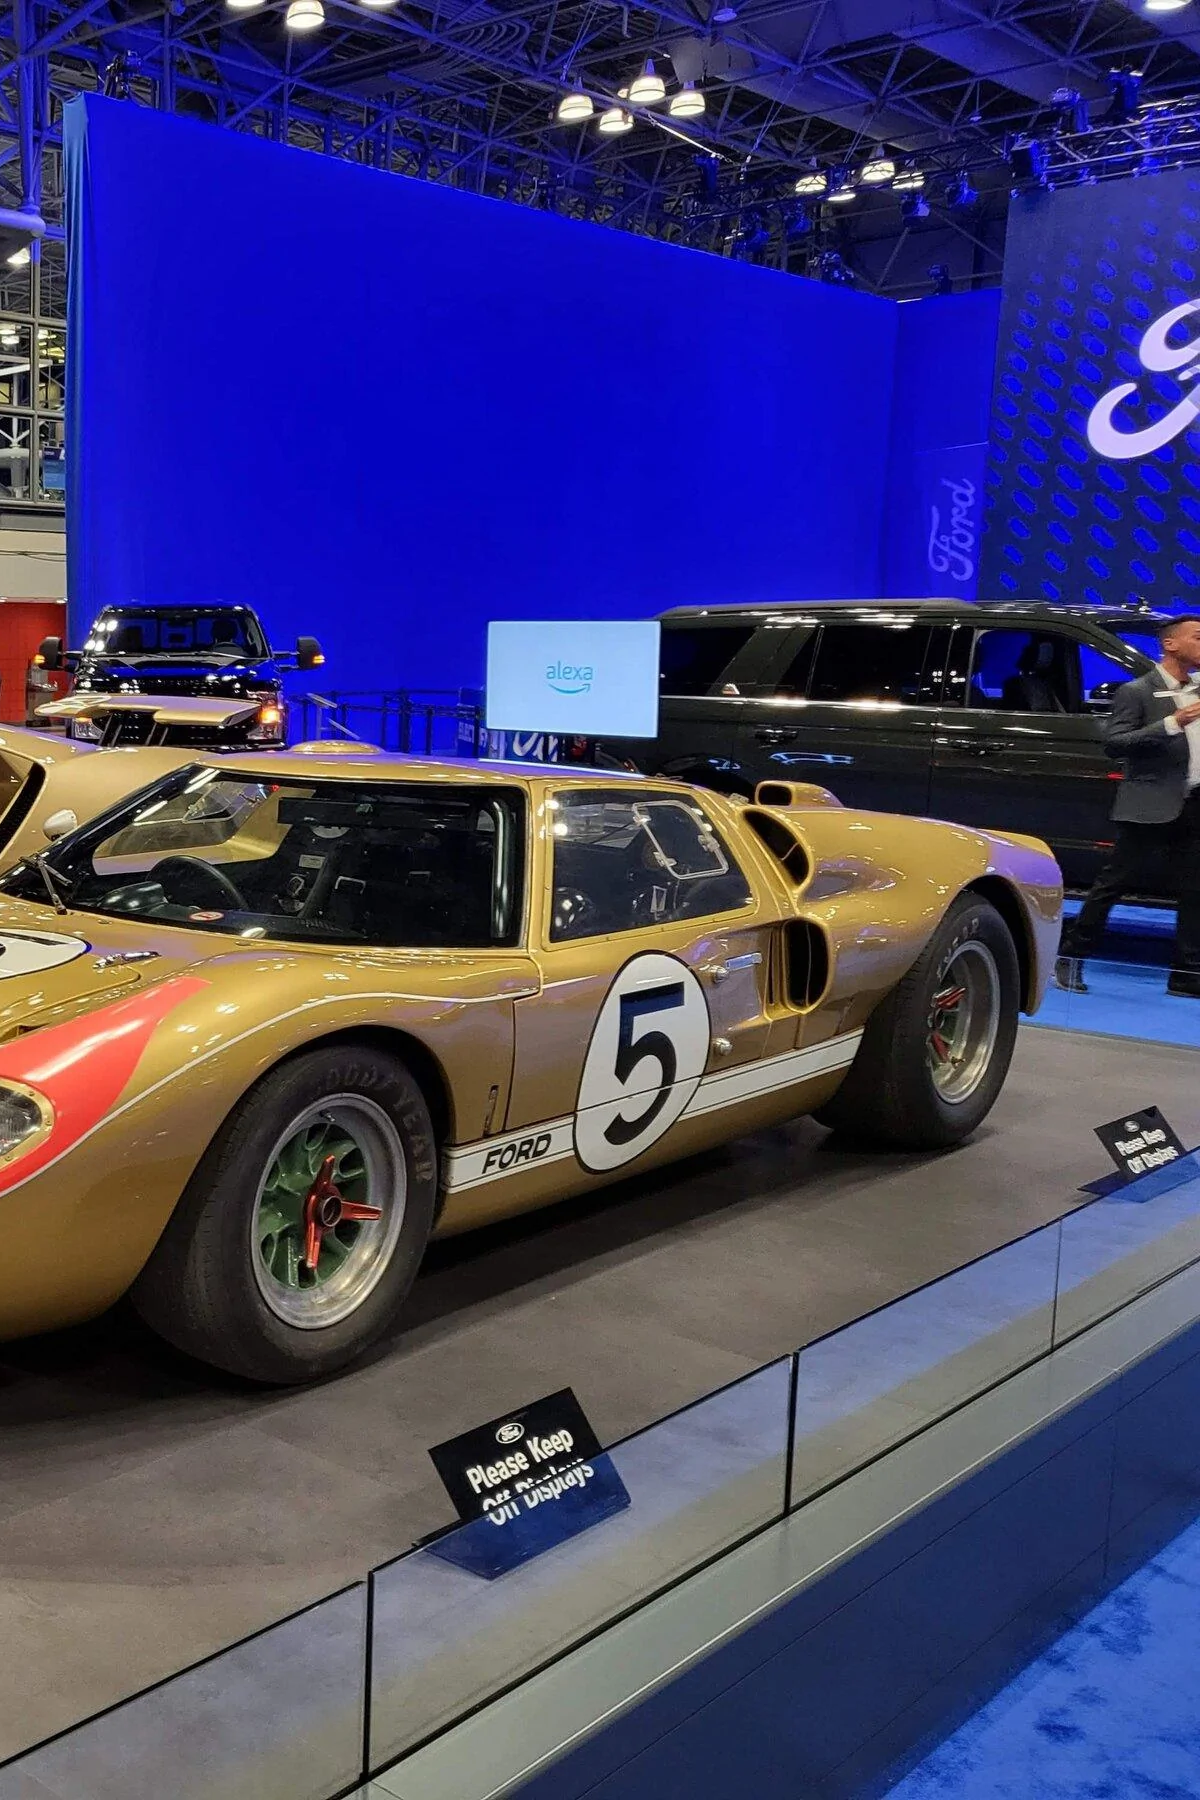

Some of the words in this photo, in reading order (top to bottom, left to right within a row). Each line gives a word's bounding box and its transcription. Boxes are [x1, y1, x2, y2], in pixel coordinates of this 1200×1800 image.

[928, 478, 976, 581] Ford
[546, 661, 593, 680] alexa
[604, 981, 685, 1146] 5
[310, 1064, 434, 1184] OODYEAR
[482, 1133, 552, 1174] FORD
[466, 1452, 530, 1494] Please
[526, 1429, 574, 1463] Keep
[483, 1489, 521, 1525] Off
[515, 1458, 594, 1508] Displays
